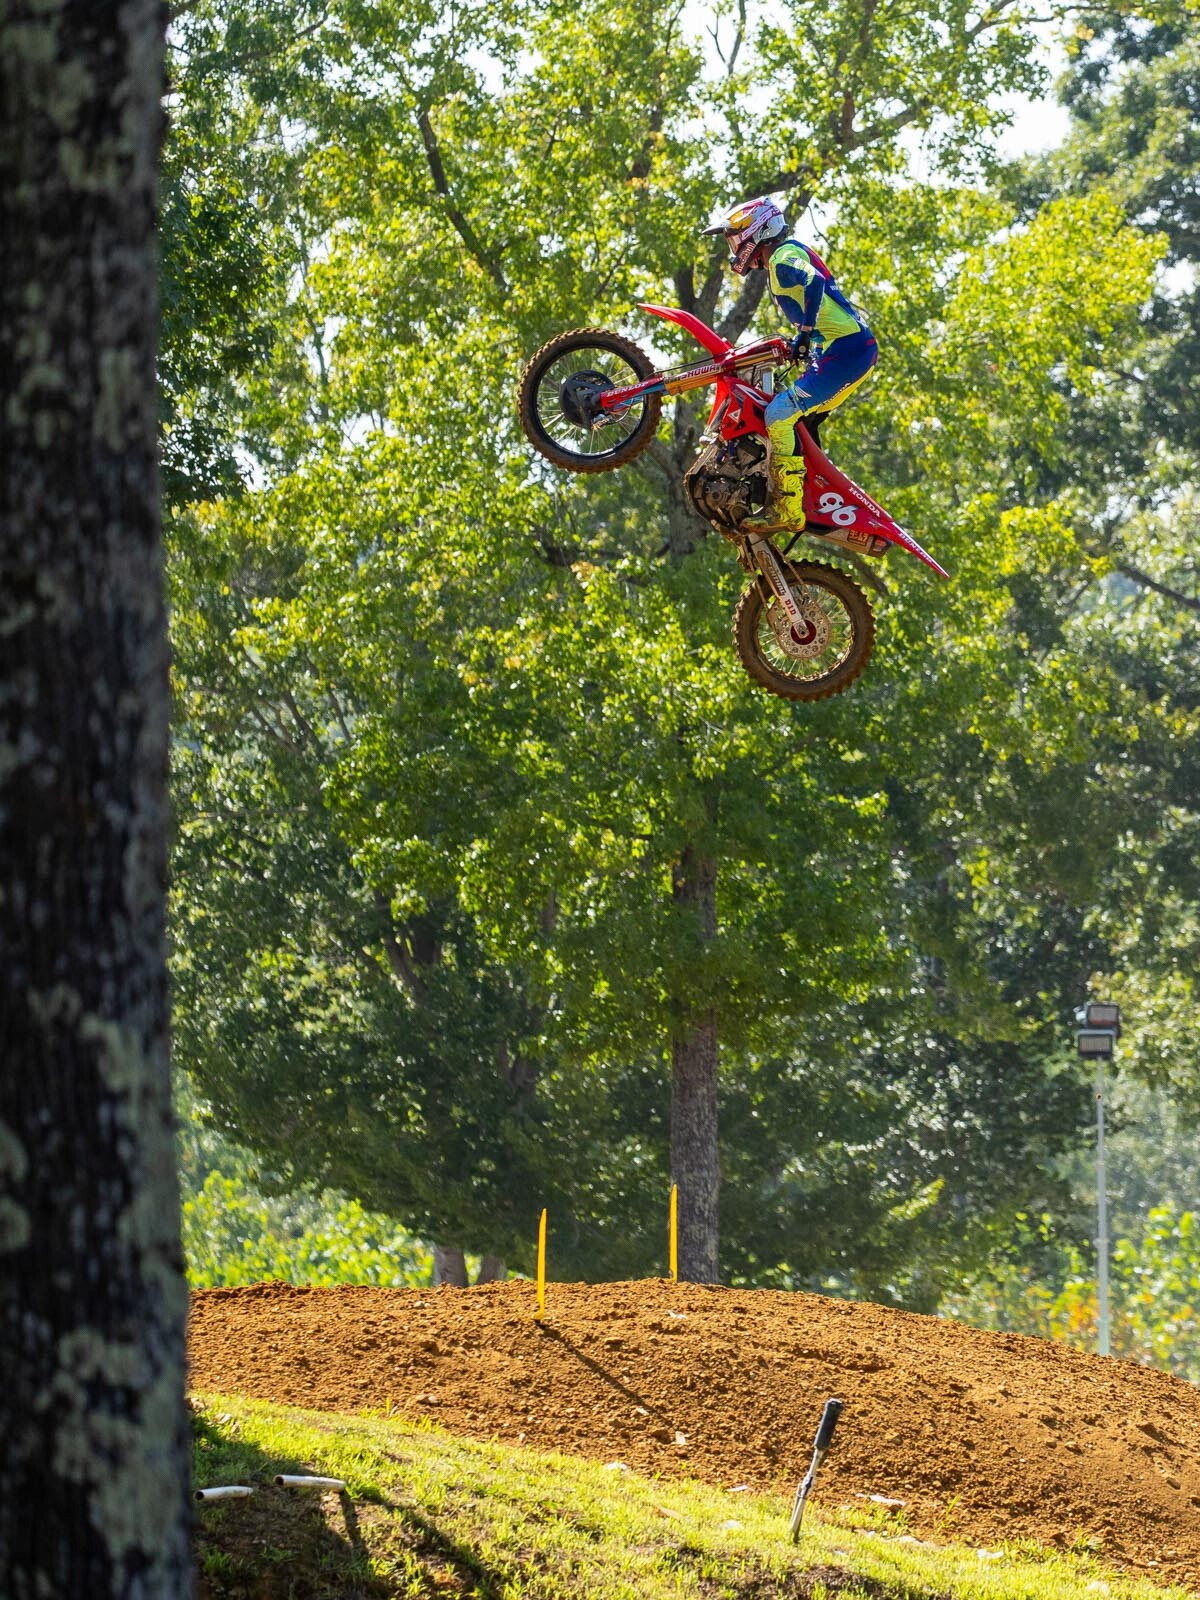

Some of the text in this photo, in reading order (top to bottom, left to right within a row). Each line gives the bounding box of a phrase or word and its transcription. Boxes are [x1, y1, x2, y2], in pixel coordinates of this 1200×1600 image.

[678, 364, 717, 381] SHOWA
[814, 491, 860, 526] 96
[849, 487, 881, 518] HONDA
